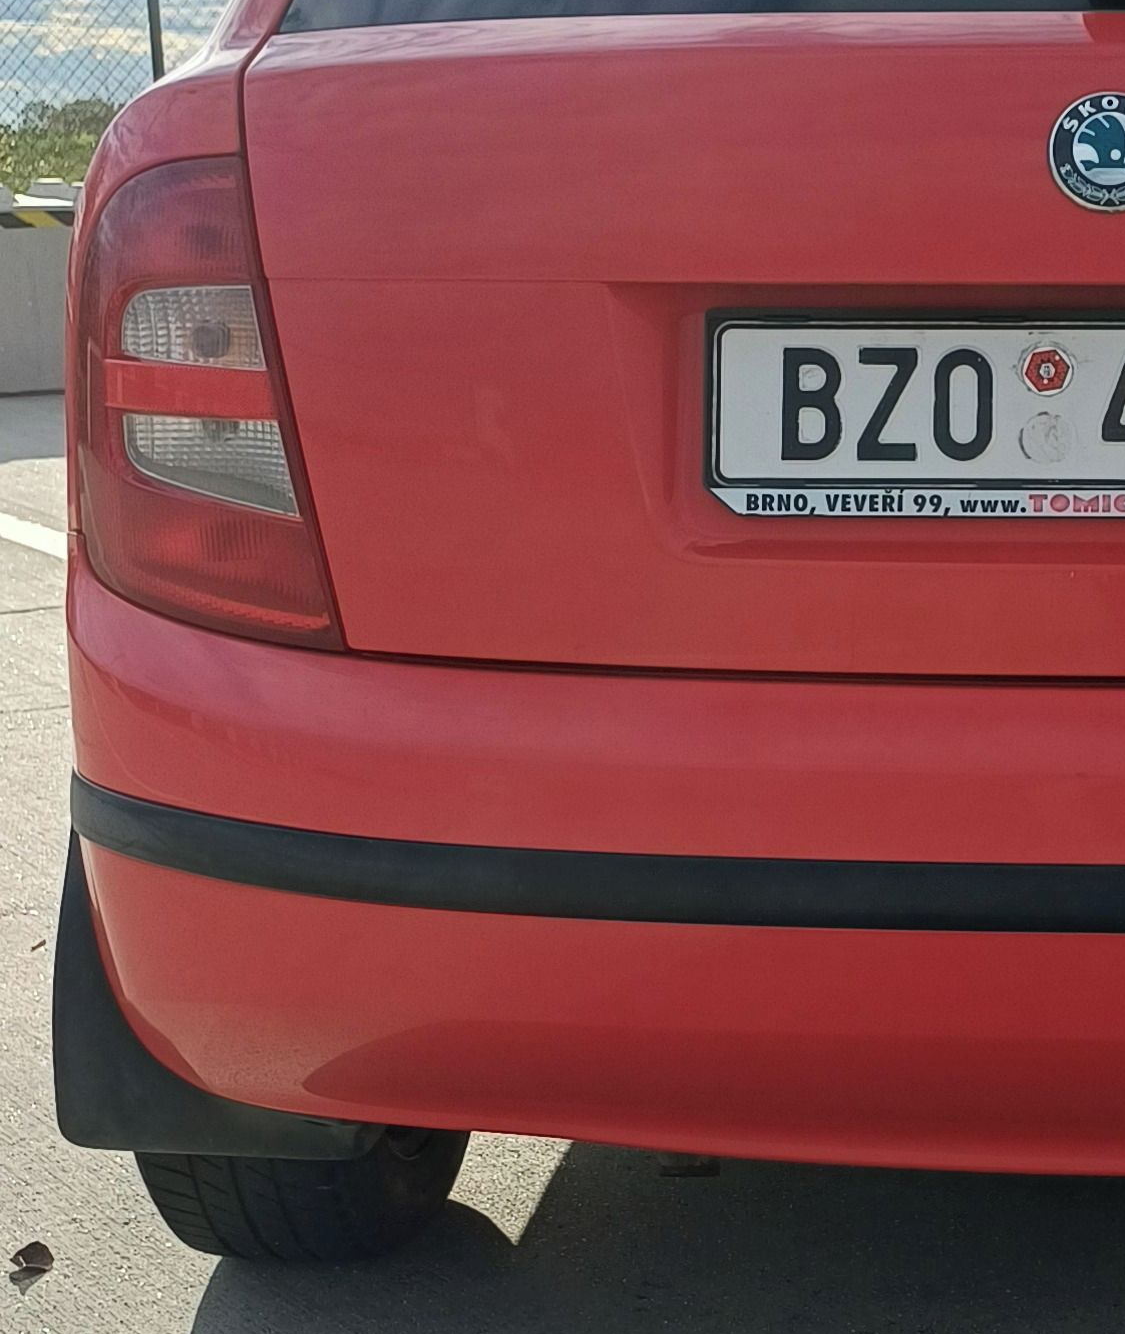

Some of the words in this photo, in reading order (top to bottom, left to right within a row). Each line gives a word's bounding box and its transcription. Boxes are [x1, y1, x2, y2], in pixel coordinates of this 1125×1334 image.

[780, 347, 995, 462] BZO
[745, 493, 817, 515] BRNO,
[825, 488, 904, 513] VEVEŘÍ
[912, 494, 951, 517] 99,
